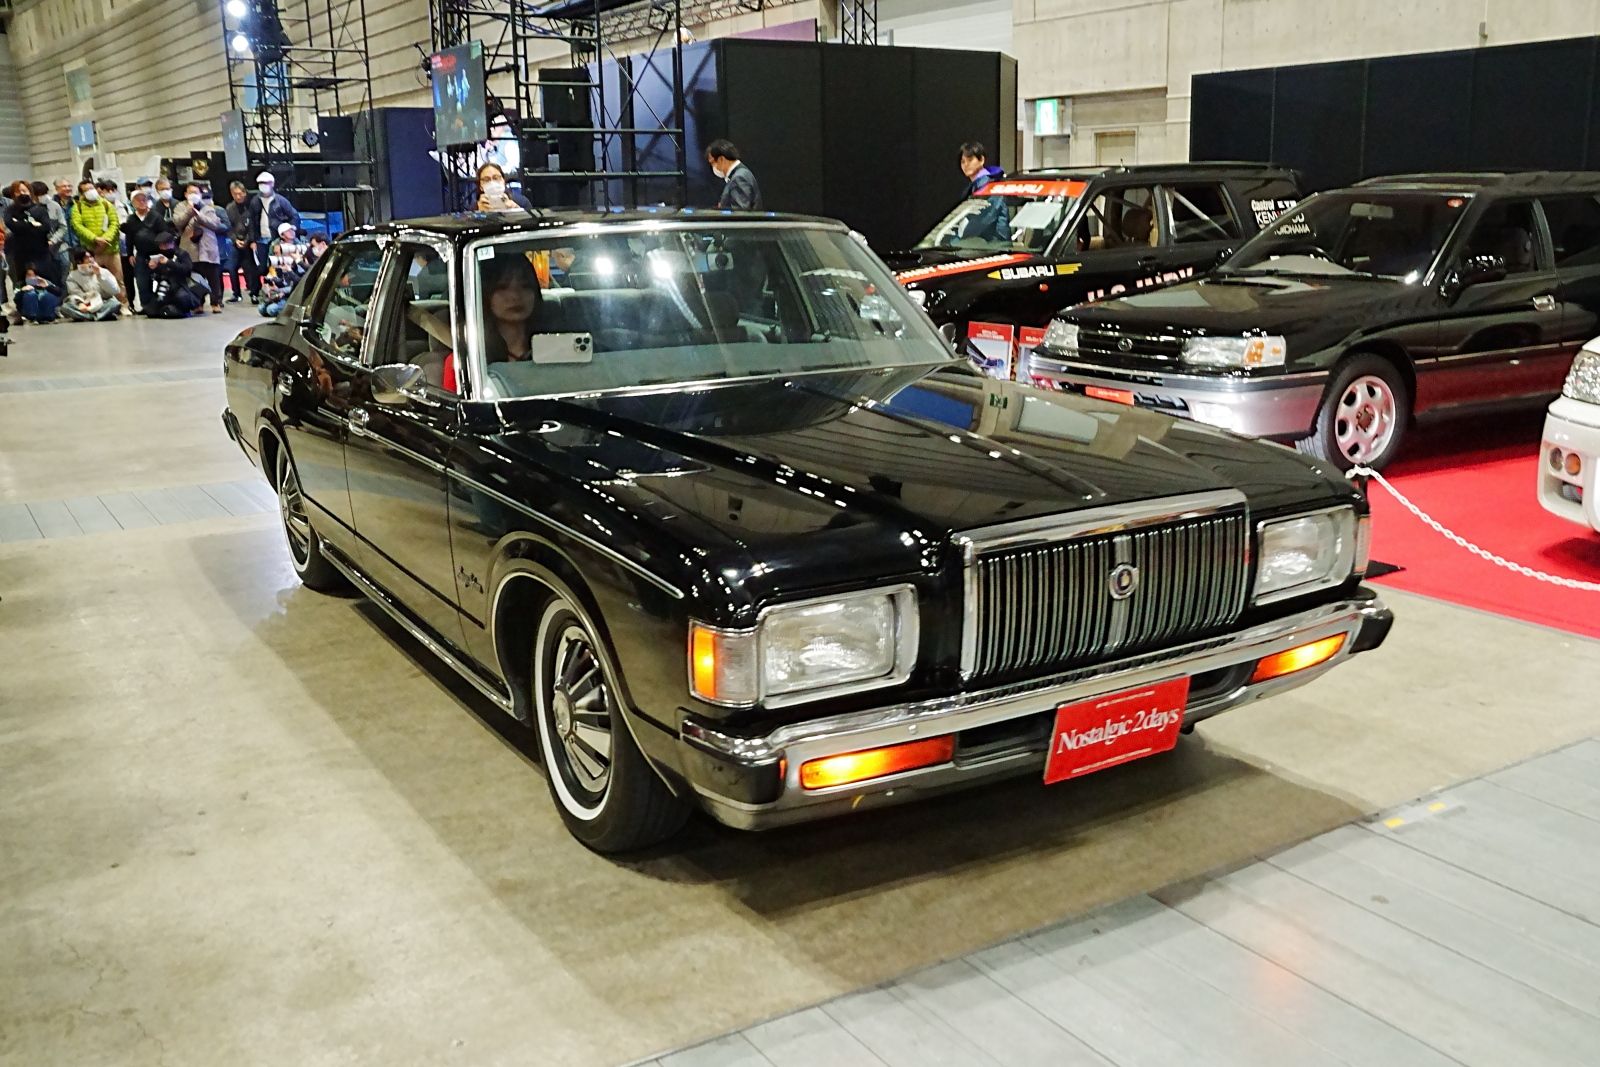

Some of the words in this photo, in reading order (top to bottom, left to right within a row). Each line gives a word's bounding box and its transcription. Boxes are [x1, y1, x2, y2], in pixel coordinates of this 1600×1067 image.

[1251, 199, 1275, 211] Castrol
[1001, 264, 1055, 280] SUBARU
[1056, 715, 1133, 754] Nostalgic
[1131, 707, 1181, 732] 2days
